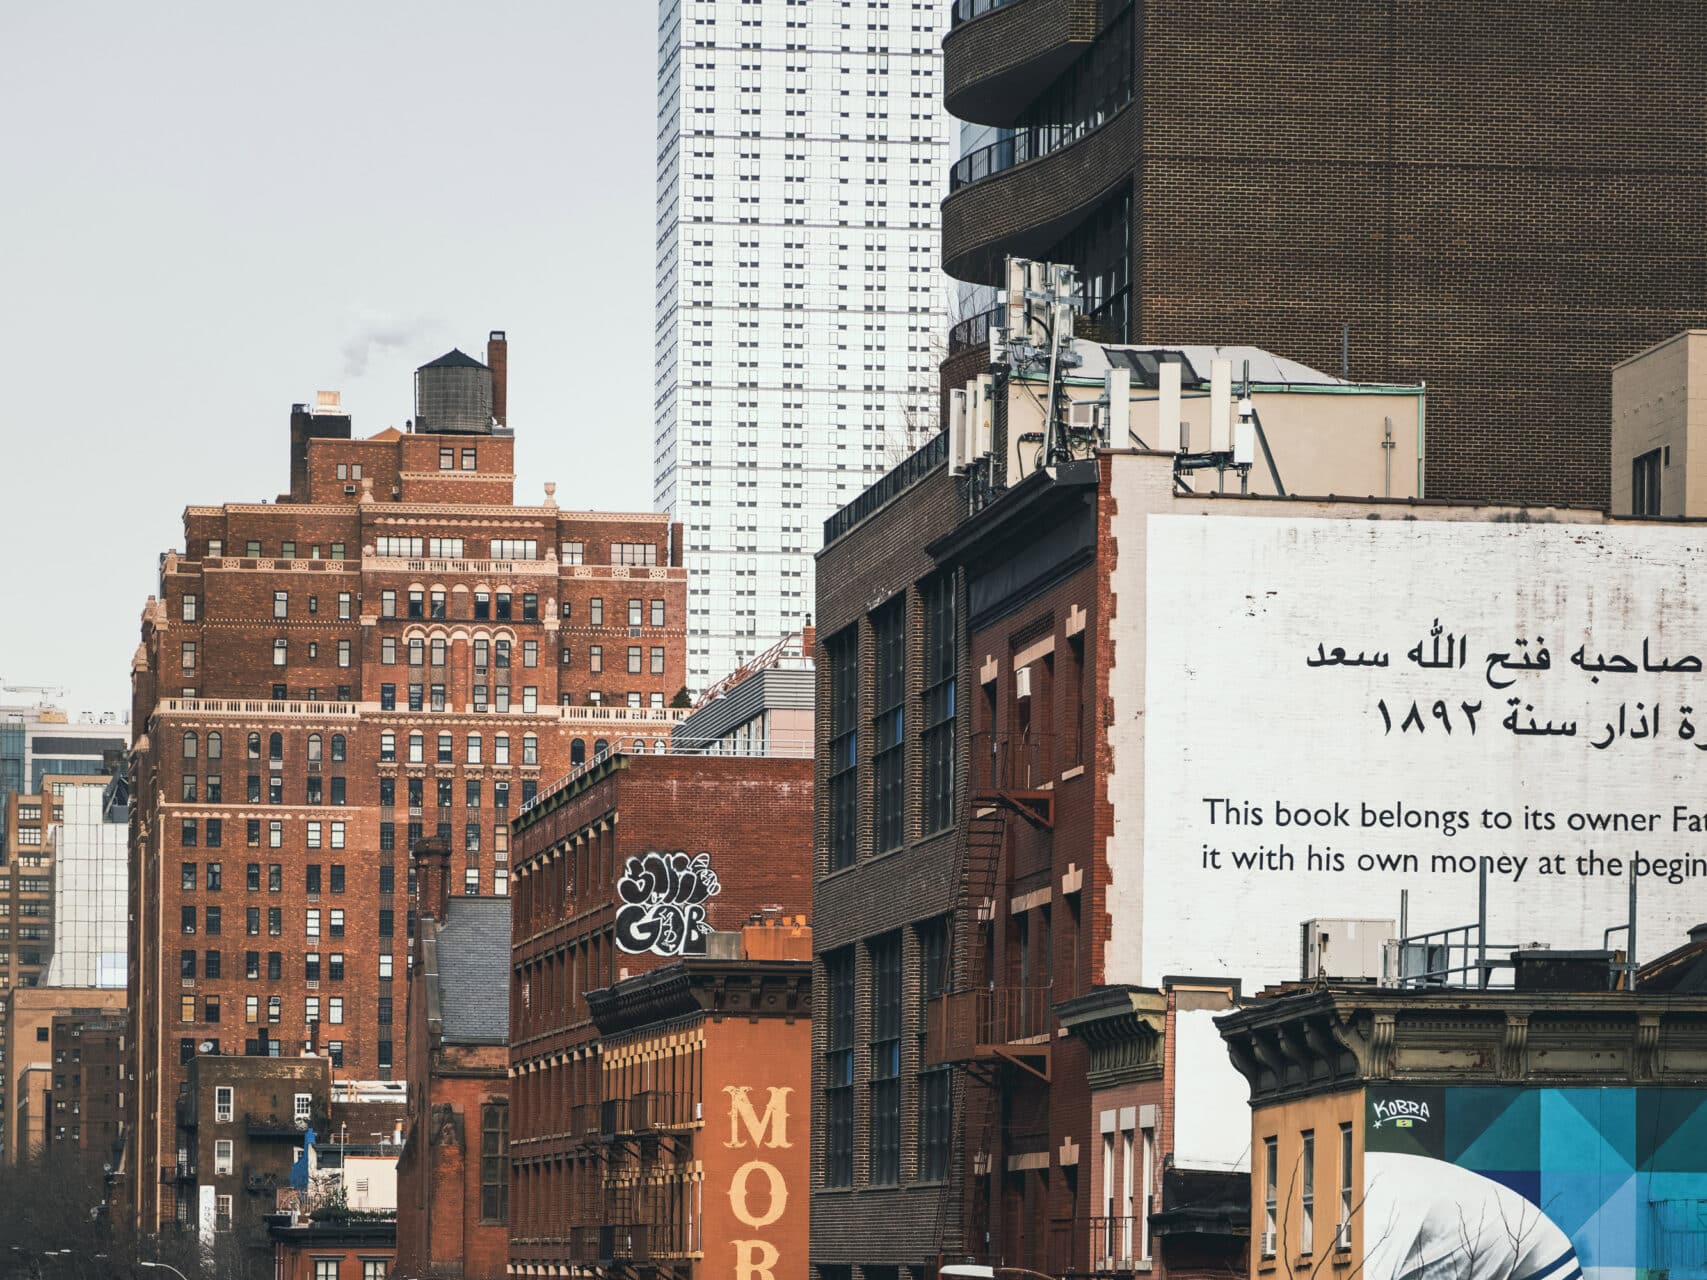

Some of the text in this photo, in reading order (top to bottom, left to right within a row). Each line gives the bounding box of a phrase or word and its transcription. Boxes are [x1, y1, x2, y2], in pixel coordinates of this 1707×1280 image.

[1306, 643, 1389, 668] سعد
[1486, 636, 1551, 690] فتح
[1570, 636, 1703, 684] صاحبه
[1378, 699, 1482, 735] ١٨٩٢
[1502, 697, 1577, 737] سنة
[1590, 702, 1660, 750] اذار
[1202, 798, 1263, 826] This
[1275, 800, 1350, 827] book
[1361, 801, 1470, 837] belongs
[1481, 809, 1512, 830] to
[1524, 805, 1556, 831] its
[1567, 813, 1662, 832] owner
[1202, 844, 1222, 870] it
[1231, 844, 1294, 871] with
[1307, 844, 1345, 872] his
[1357, 854, 1418, 873] own
[1431, 855, 1528, 882] money
[1538, 854, 1566, 875] at
[1575, 849, 1623, 877] the
[1373, 1099, 1430, 1118] KOBRA
